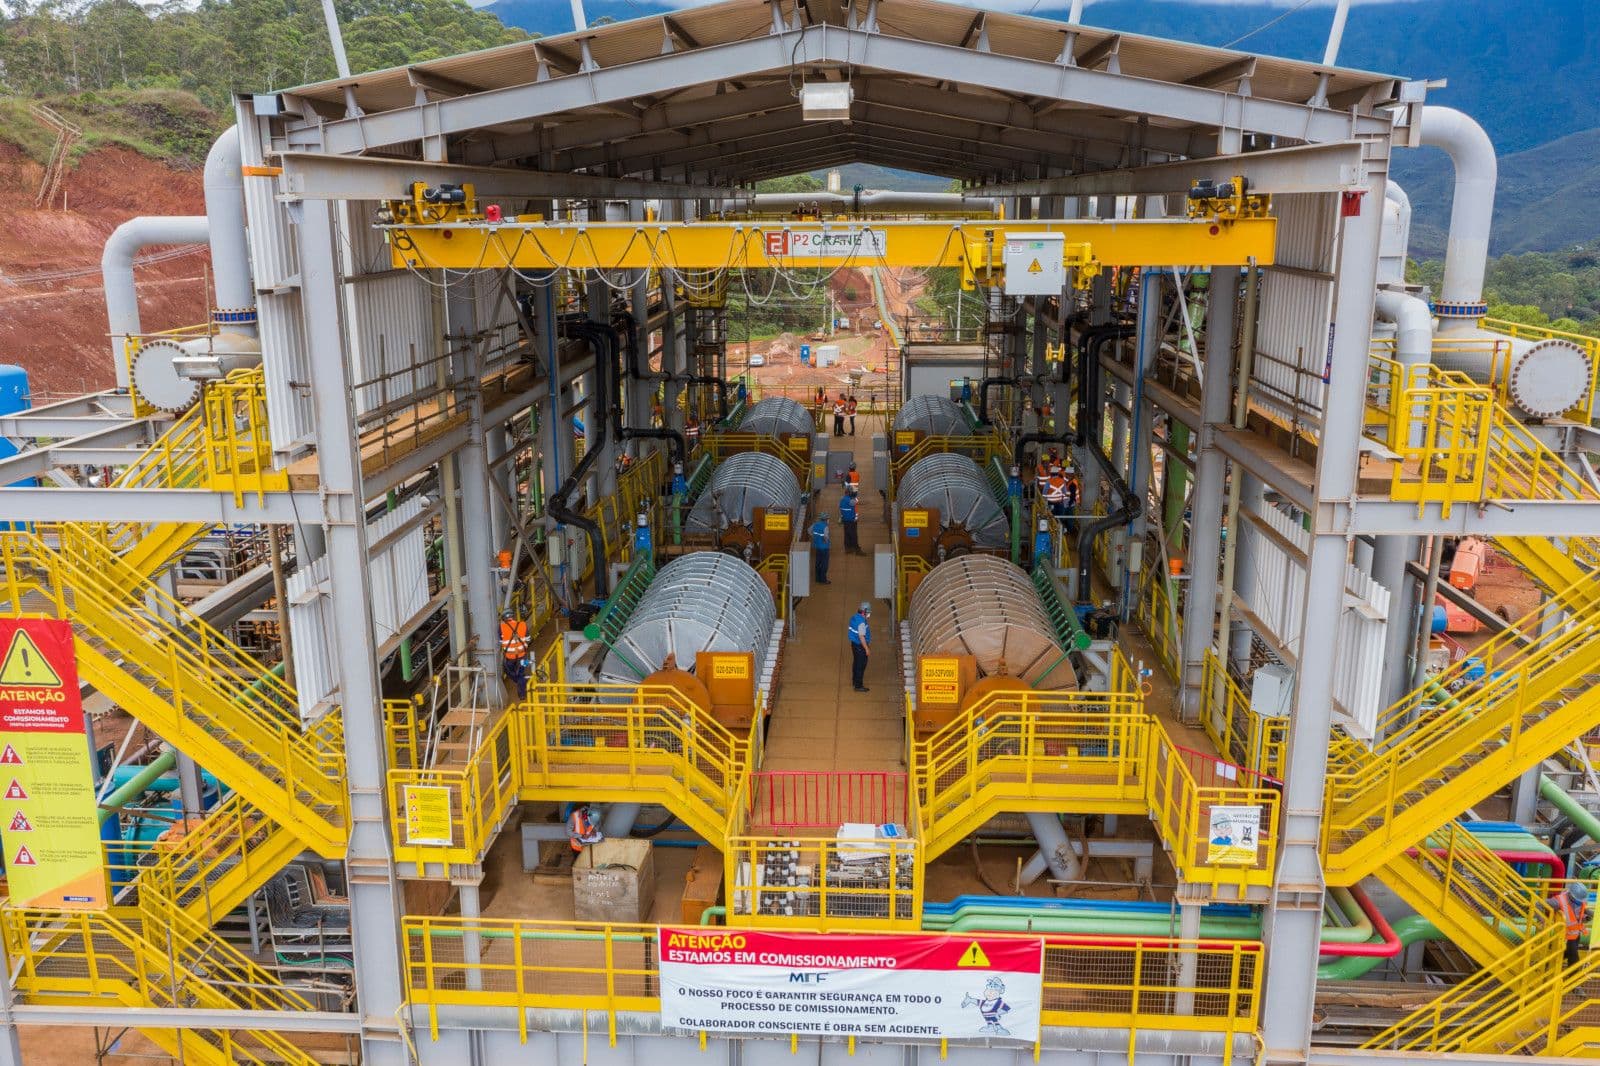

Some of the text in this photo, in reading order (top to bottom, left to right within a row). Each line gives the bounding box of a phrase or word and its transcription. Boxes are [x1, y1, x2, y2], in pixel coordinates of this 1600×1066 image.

[793, 234, 809, 246] P2
[812, 234, 862, 246] CRANE
[0, 689, 65, 704] ATENÇÃO
[668, 933, 746, 952] ATENÇÃO
[668, 950, 897, 968] ESTAMOS EM COMISSIONAMENTO
[678, 987, 942, 1004] O NOSSO FOCO É GARANTIR SEGURANÇA EM TODO O
[720, 1002, 899, 1015] PROCESSO DE COMISSIONAMENTO.
[679, 1017, 942, 1035] COLABORADOR CONSCIENTE É OBRA SEM ACIDENTE.
